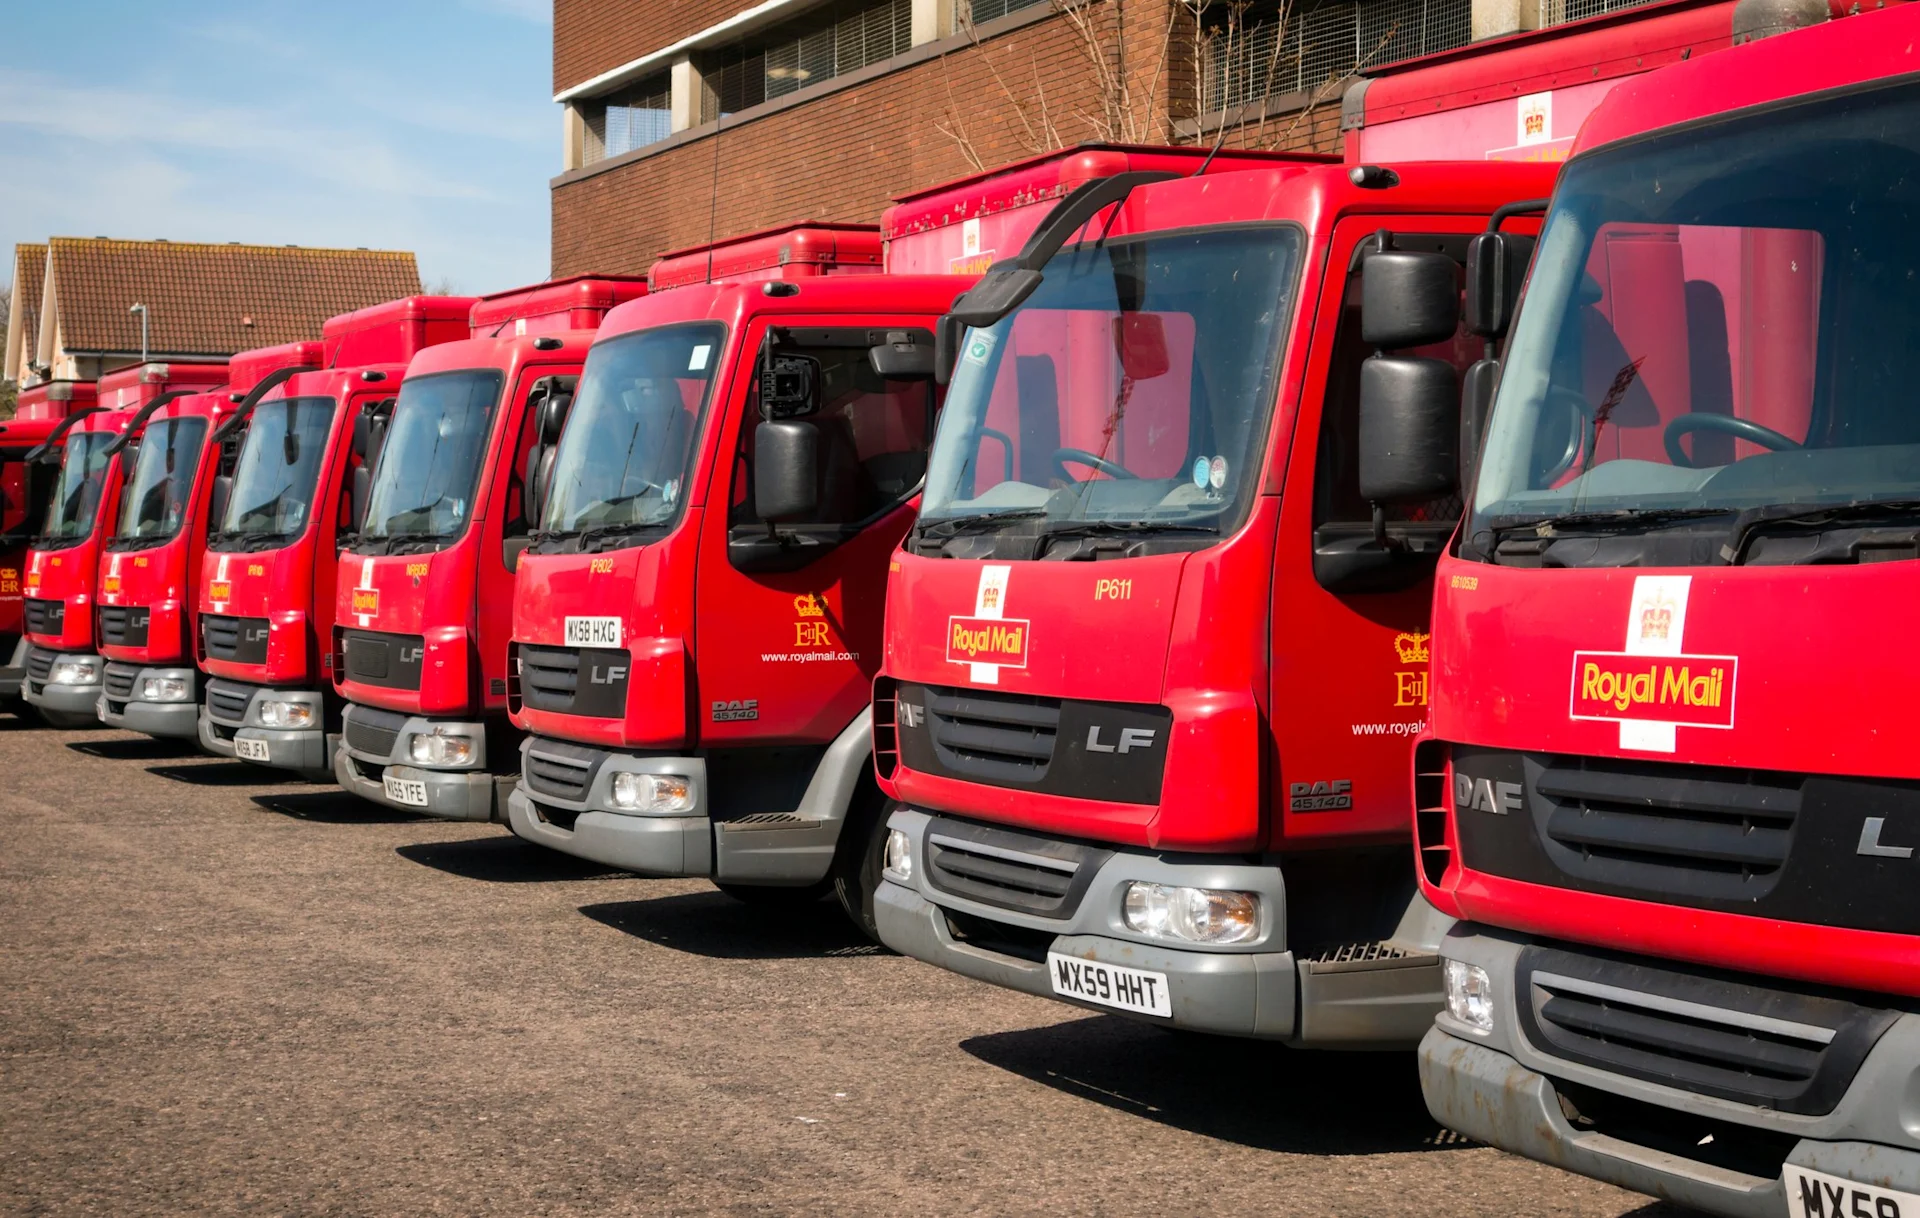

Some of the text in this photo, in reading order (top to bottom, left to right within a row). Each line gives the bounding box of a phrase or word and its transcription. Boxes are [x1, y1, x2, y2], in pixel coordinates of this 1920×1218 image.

[590, 558, 613, 573] IP802
[1095, 578, 1132, 601] IP611
[131, 616, 149, 628] LF
[567, 620, 615, 642] MX58 HXG
[245, 628, 269, 642] LF
[953, 624, 1022, 657] Royal Mail
[400, 647, 424, 663] LF
[761, 651, 860, 664] www.royalmail.com
[590, 665, 628, 685] LF
[1582, 662, 1723, 711] Royal Mail
[712, 699, 758, 711] DAF
[1086, 725, 1156, 754] LF
[403, 783, 424, 803] YFE
[1290, 779, 1352, 797] DAF
[1456, 772, 1523, 816] DAF
[1291, 796, 1350, 811] 45.140
[1856, 816, 1914, 859] L
[1057, 959, 1157, 1009] MX59 HHT
